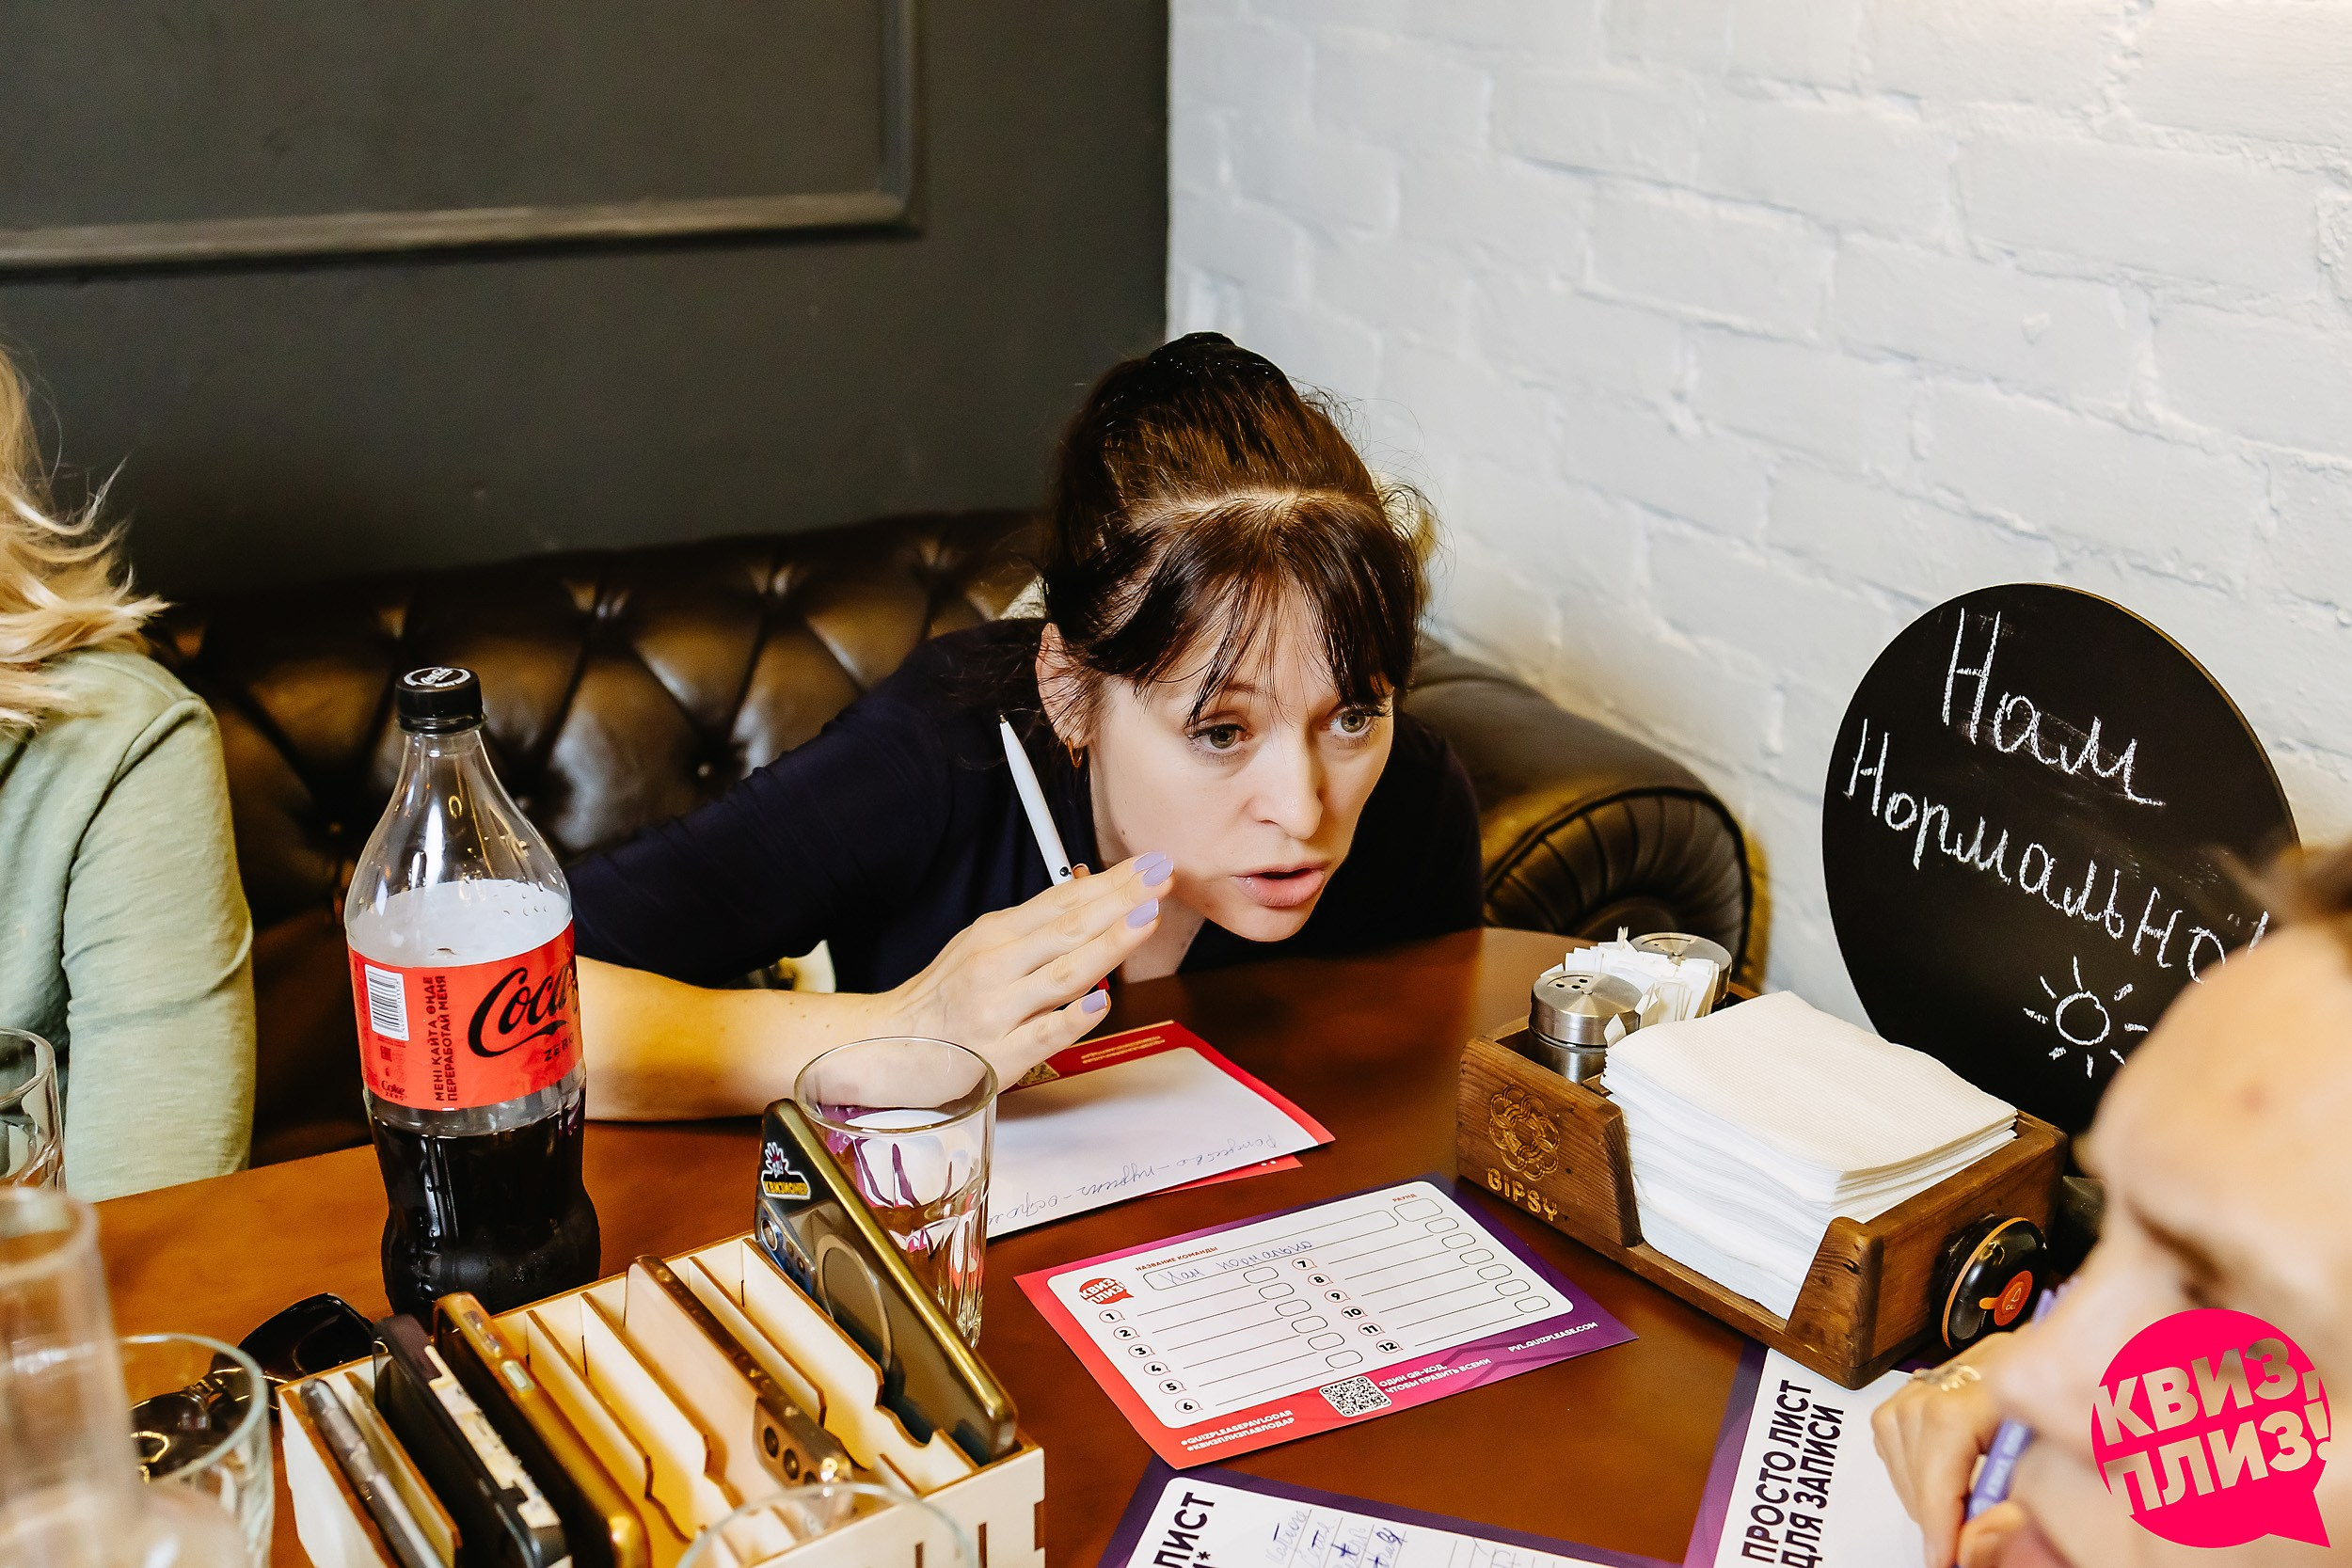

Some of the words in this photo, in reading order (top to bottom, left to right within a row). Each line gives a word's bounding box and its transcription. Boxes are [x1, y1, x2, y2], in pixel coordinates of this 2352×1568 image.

[1941, 608, 2166, 806] Нам
[435, 975, 450, 1014] МЕНЯ
[440, 1014, 458, 1101] ПЕРЕРАБОТАЙ
[1135, 1257, 1176, 1272] НАЗВАНИЕ
[1177, 1246, 1218, 1260] КОМАНДЫ
[1343, 1308, 1362, 1318] 10
[1119, 1329, 1131, 1338] 2
[1362, 1324, 1379, 1334] 11
[1507, 1321, 1599, 1353] PVL.QUIZPLEASE.COM
[1135, 1347, 1147, 1355] 3
[1379, 1342, 1398, 1352] 12
[1151, 1364, 1162, 1372] 4
[1378, 1374, 1407, 1387] ОДИН
[1384, 1379, 1420, 1394] ЧТОБЫ
[1418, 1368, 1460, 1385] ПРАВИТЬ
[1457, 1357, 1492, 1372] ВСЕМИ
[1166, 1383, 1177, 1391] 5
[1183, 1402, 1193, 1411] 6
[1768, 1379, 1812, 1449] ЛИСТ
[1792, 1403, 1845, 1510] ЗАПИСИ
[1740, 1450, 1797, 1564] ПРОСТО
[1152, 1491, 1216, 1568] ЛИСТ
[1780, 1512, 1823, 1568] ДЛЯ
